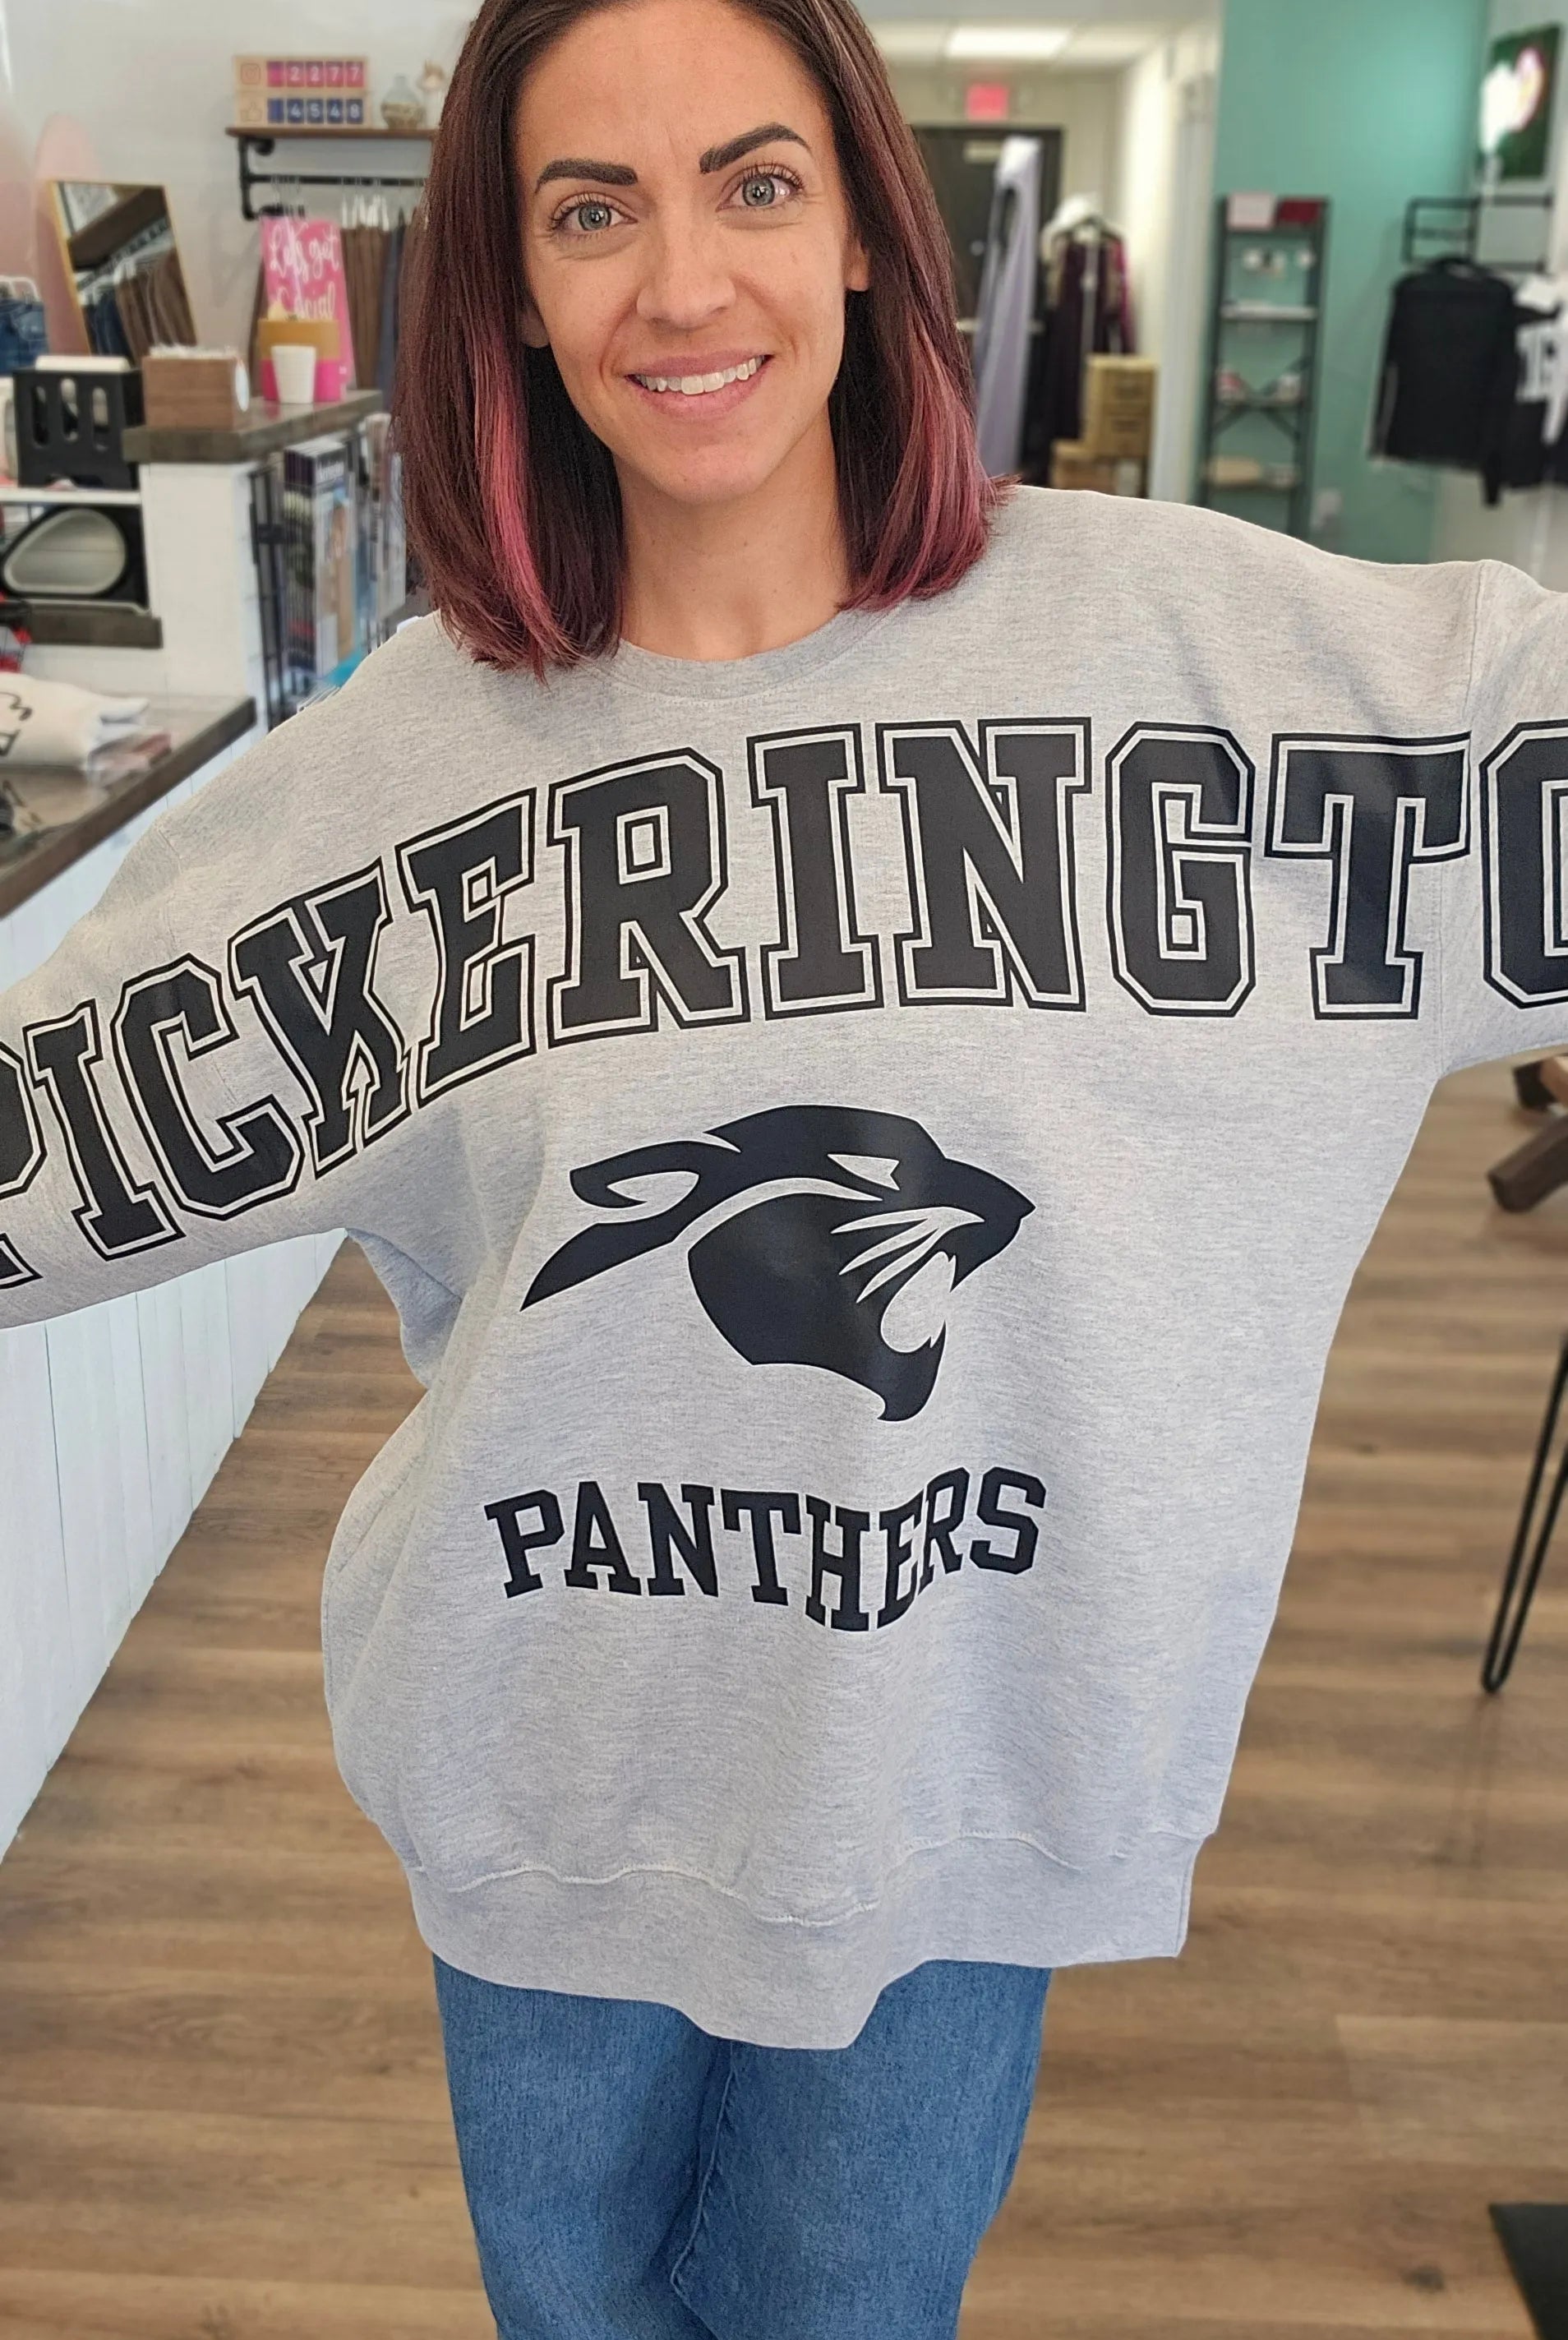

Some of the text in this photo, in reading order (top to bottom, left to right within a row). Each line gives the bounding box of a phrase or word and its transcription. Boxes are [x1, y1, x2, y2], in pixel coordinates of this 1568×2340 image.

[289, 65, 360, 82] 2277
[290, 102, 360, 120] 4548
[483, 1466, 1047, 1632] PANTHERS
